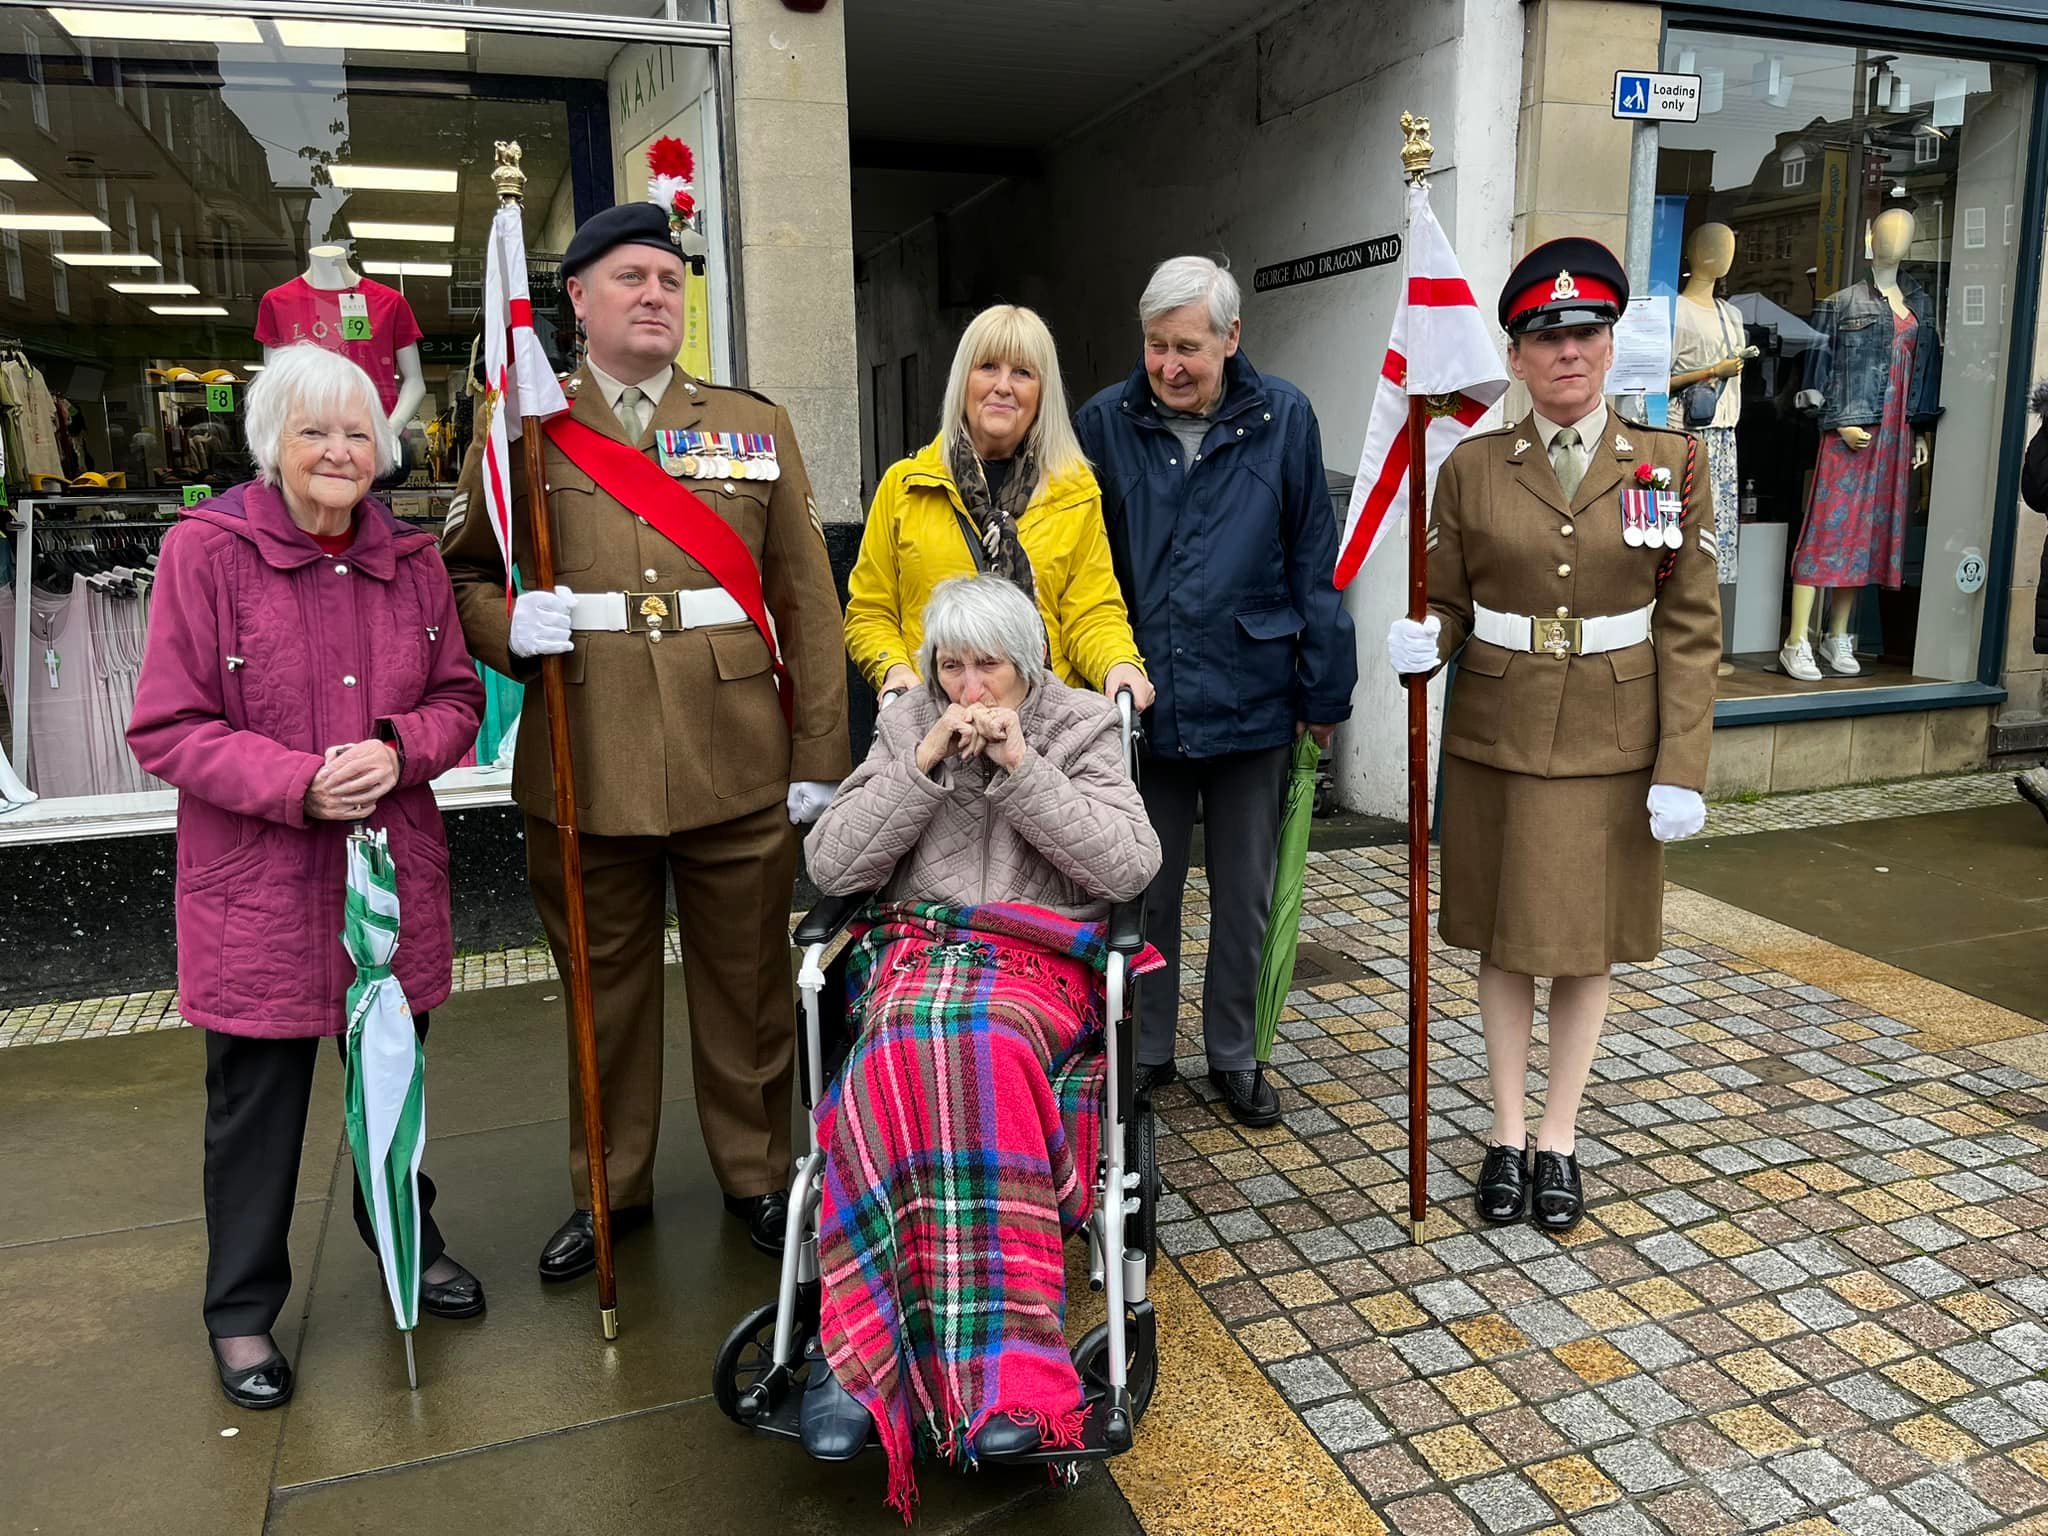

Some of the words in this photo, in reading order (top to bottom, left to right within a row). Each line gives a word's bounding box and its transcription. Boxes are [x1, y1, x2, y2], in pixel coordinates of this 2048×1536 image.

[1653, 83, 1696, 99] Loading
[1661, 99, 1685, 112] only
[1255, 266, 1290, 289] GEORGE
[1292, 260, 1315, 281] AND
[1319, 248, 1363, 275] DRAGON
[1367, 239, 1399, 263] YARD
[348, 320, 364, 336] £9
[212, 390, 228, 408] £8
